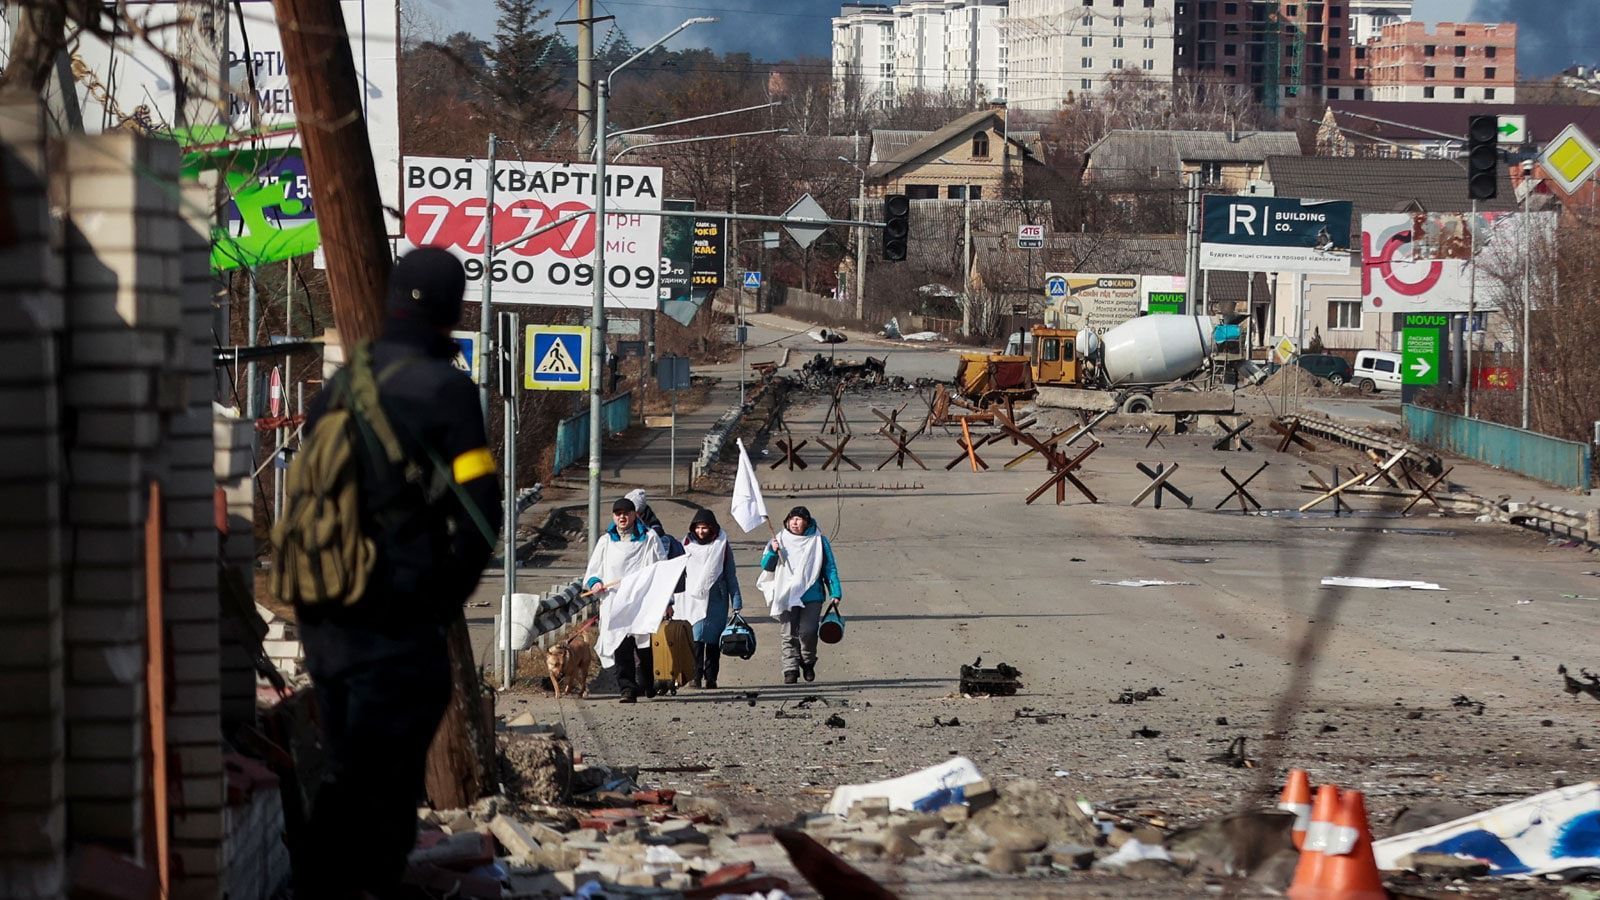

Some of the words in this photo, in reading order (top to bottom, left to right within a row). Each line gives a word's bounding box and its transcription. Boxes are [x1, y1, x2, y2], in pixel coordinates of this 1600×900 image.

[408, 166, 473, 190] ВОЯ
[486, 168, 657, 198] КВАРТИРА
[1275, 212, 1326, 222] BUILDING
[1275, 223, 1293, 232] CO.
[606, 237, 637, 253] міс
[464, 257, 534, 284] 960
[608, 264, 655, 289] 09
[1151, 293, 1184, 303] NOVUS
[1406, 315, 1447, 326] NOVUS
